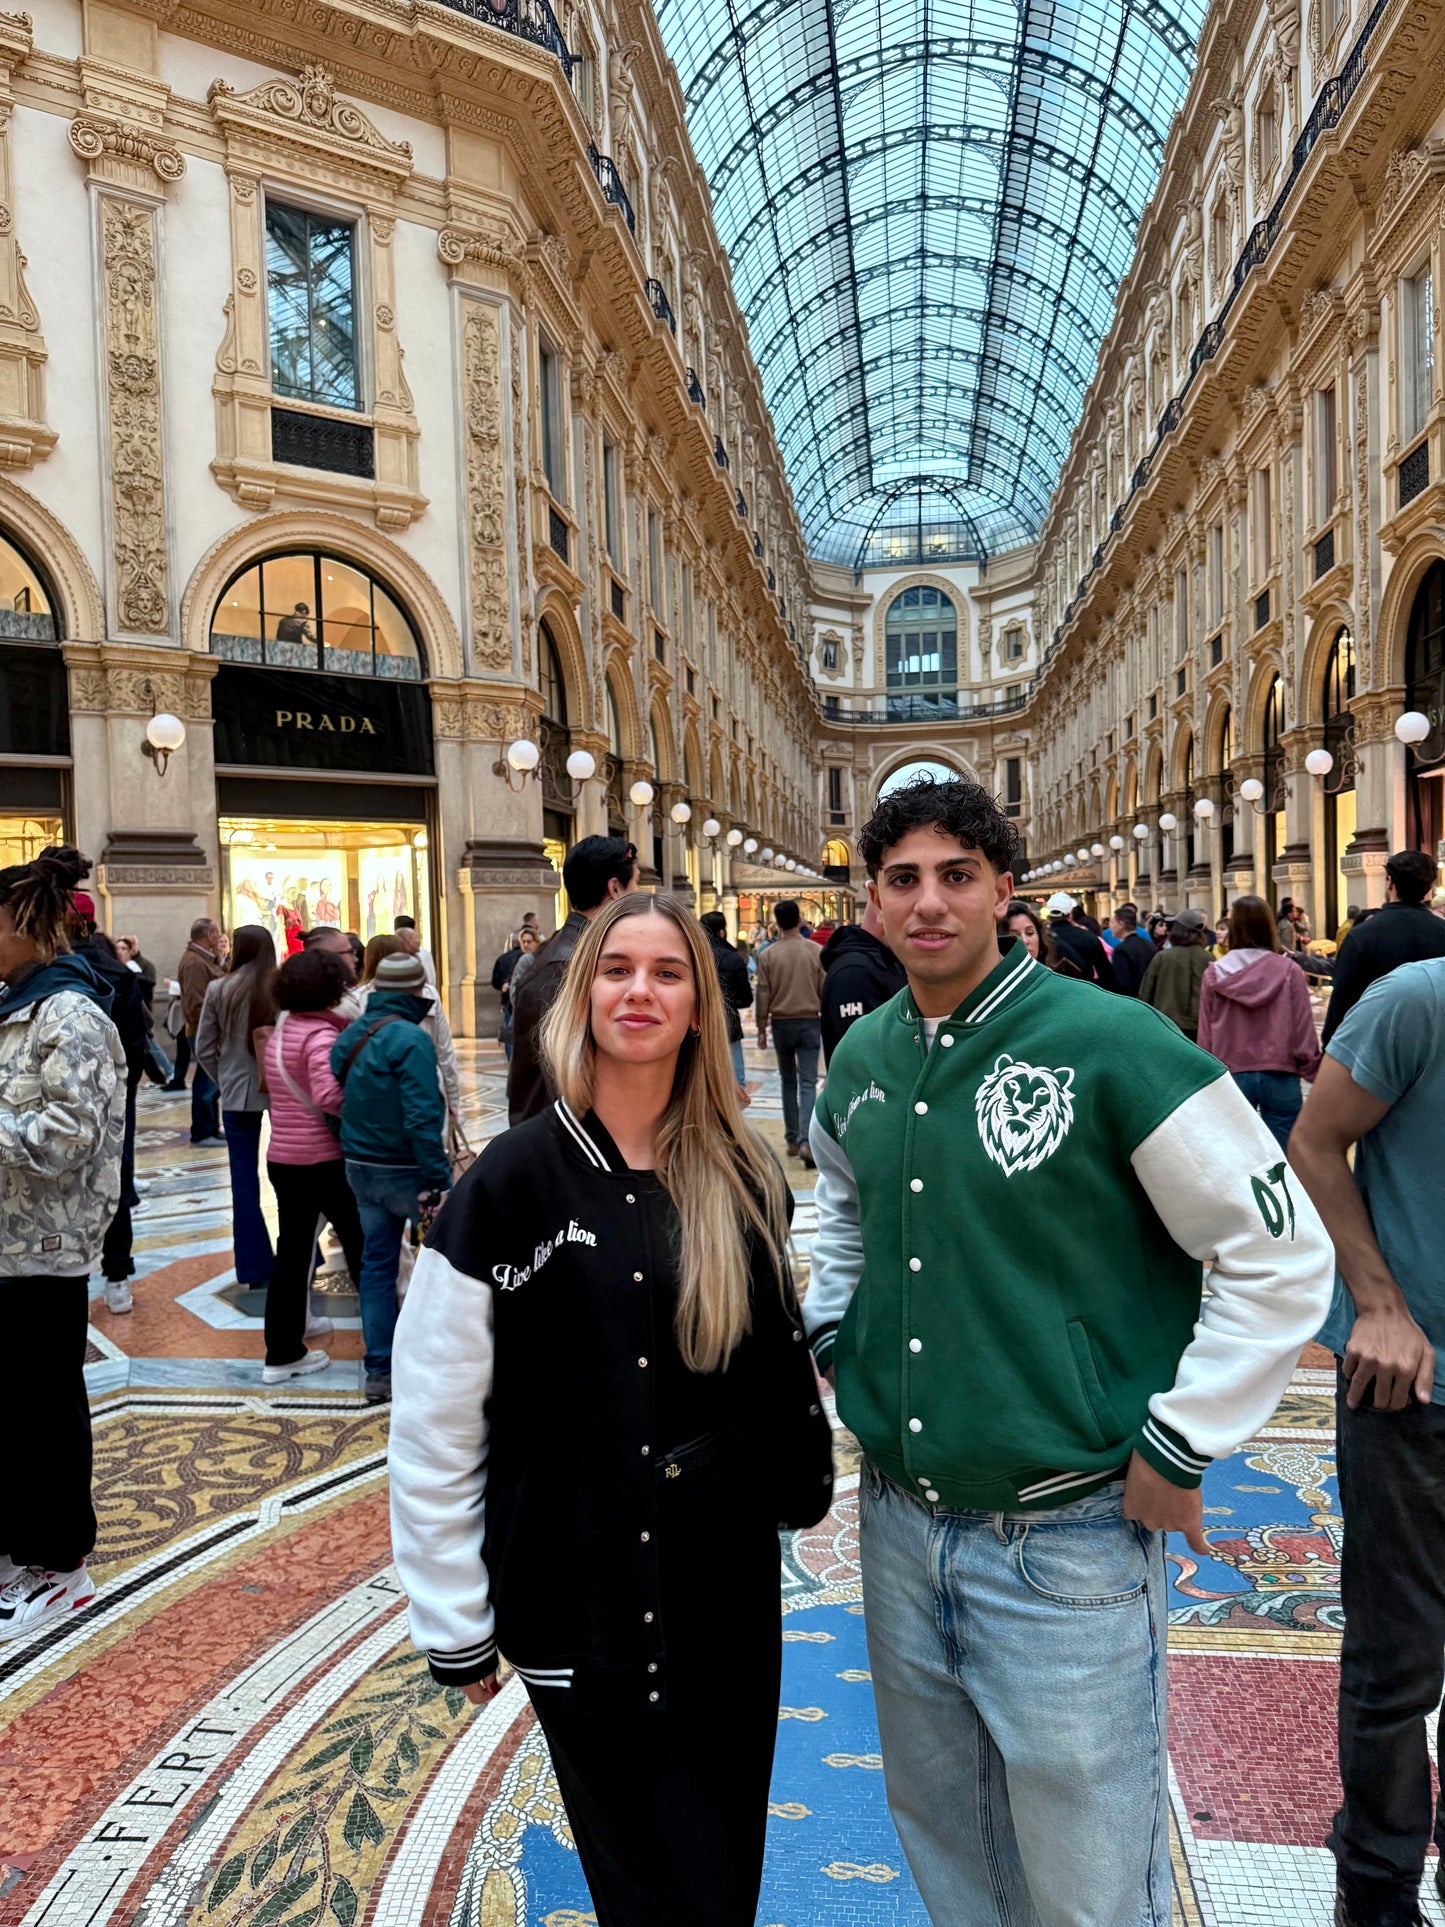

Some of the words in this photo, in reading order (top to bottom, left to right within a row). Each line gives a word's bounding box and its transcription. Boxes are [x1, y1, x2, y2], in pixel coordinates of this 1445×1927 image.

[275, 710, 377, 735] PRADA
[839, 1002, 863, 1018] HH
[869, 1080, 886, 1102] lion
[492, 1264, 532, 1291] Live
[533, 1240, 554, 1272] like
[555, 1230, 565, 1248] a
[567, 1218, 598, 1247] lion
[92, 1717, 237, 1844] FERT
